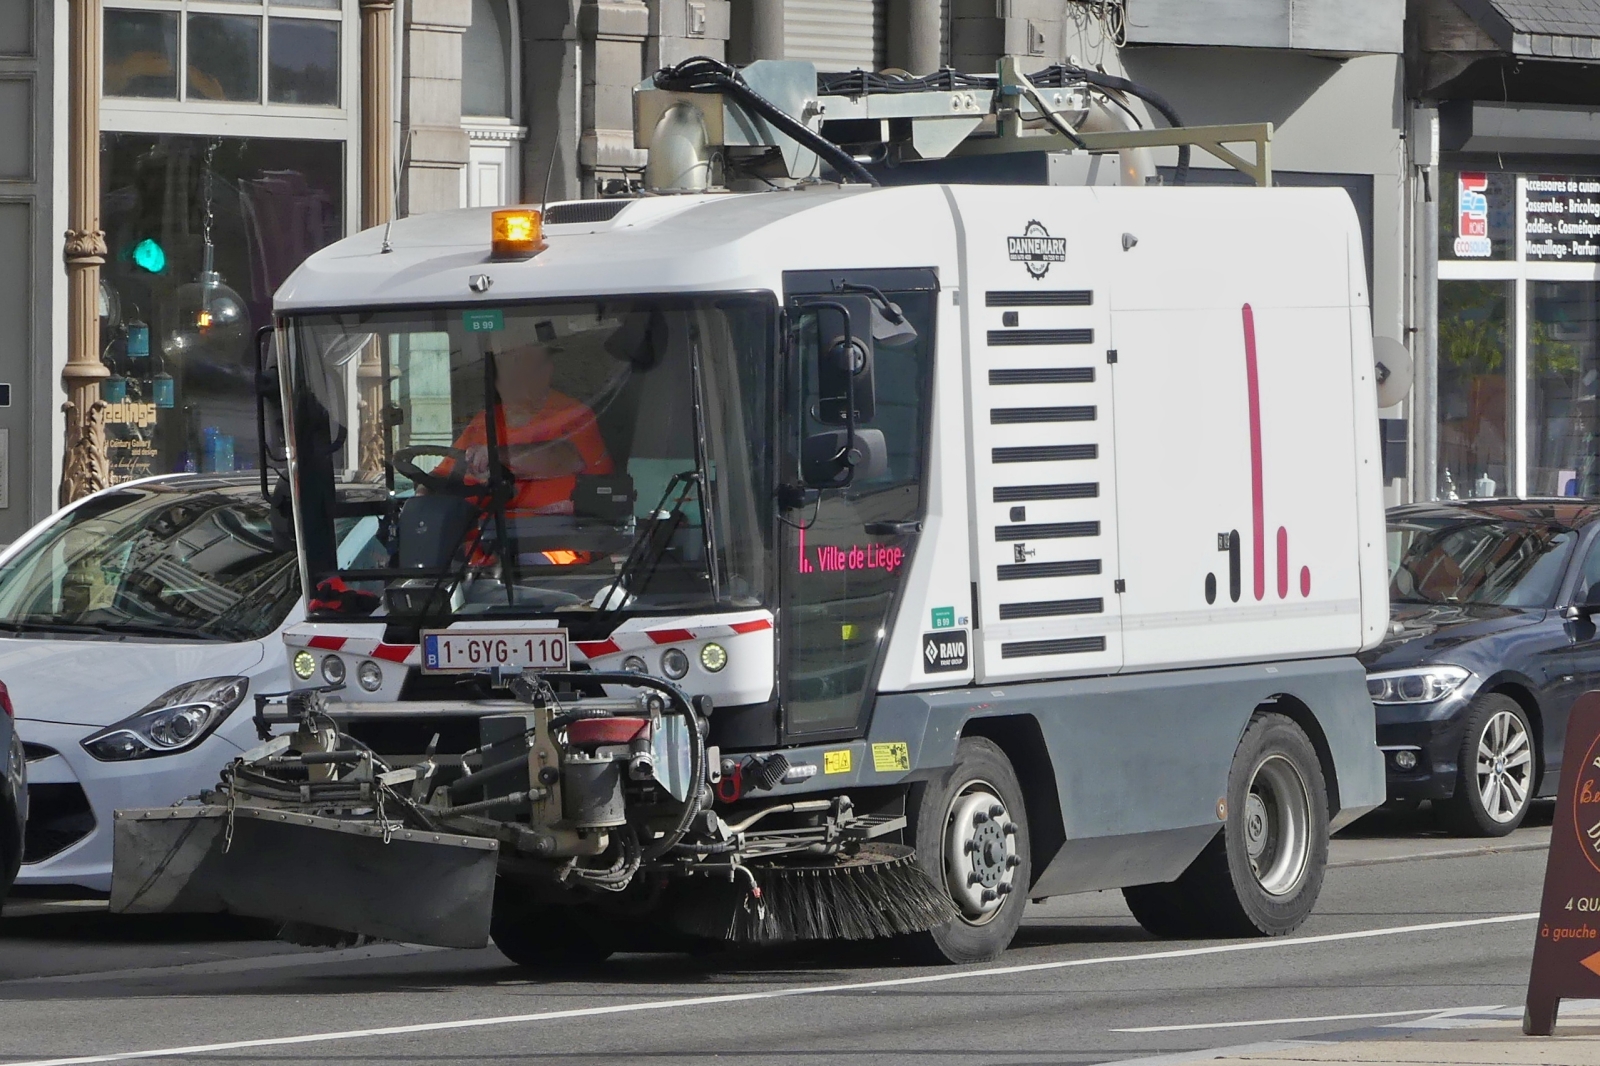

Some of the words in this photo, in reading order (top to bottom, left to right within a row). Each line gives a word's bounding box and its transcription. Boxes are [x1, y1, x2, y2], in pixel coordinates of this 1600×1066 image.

[1567, 180, 1577, 192] de
[1008, 238, 1065, 255] DANNEMARK
[1526, 239, 1567, 258] Maquillage
[473, 322, 480, 330] B
[482, 321, 494, 329] 99
[818, 546, 846, 572] Ville
[849, 544, 865, 570] de
[867, 542, 902, 572] Liège
[428, 654, 437, 666] B
[443, 640, 563, 663] 1-GYG-110
[940, 642, 965, 659] RAVO
[1564, 897, 1574, 911] 4
[1577, 897, 1600, 911] QU
[1541, 923, 1549, 937] à
[1552, 923, 1597, 942] gauche
